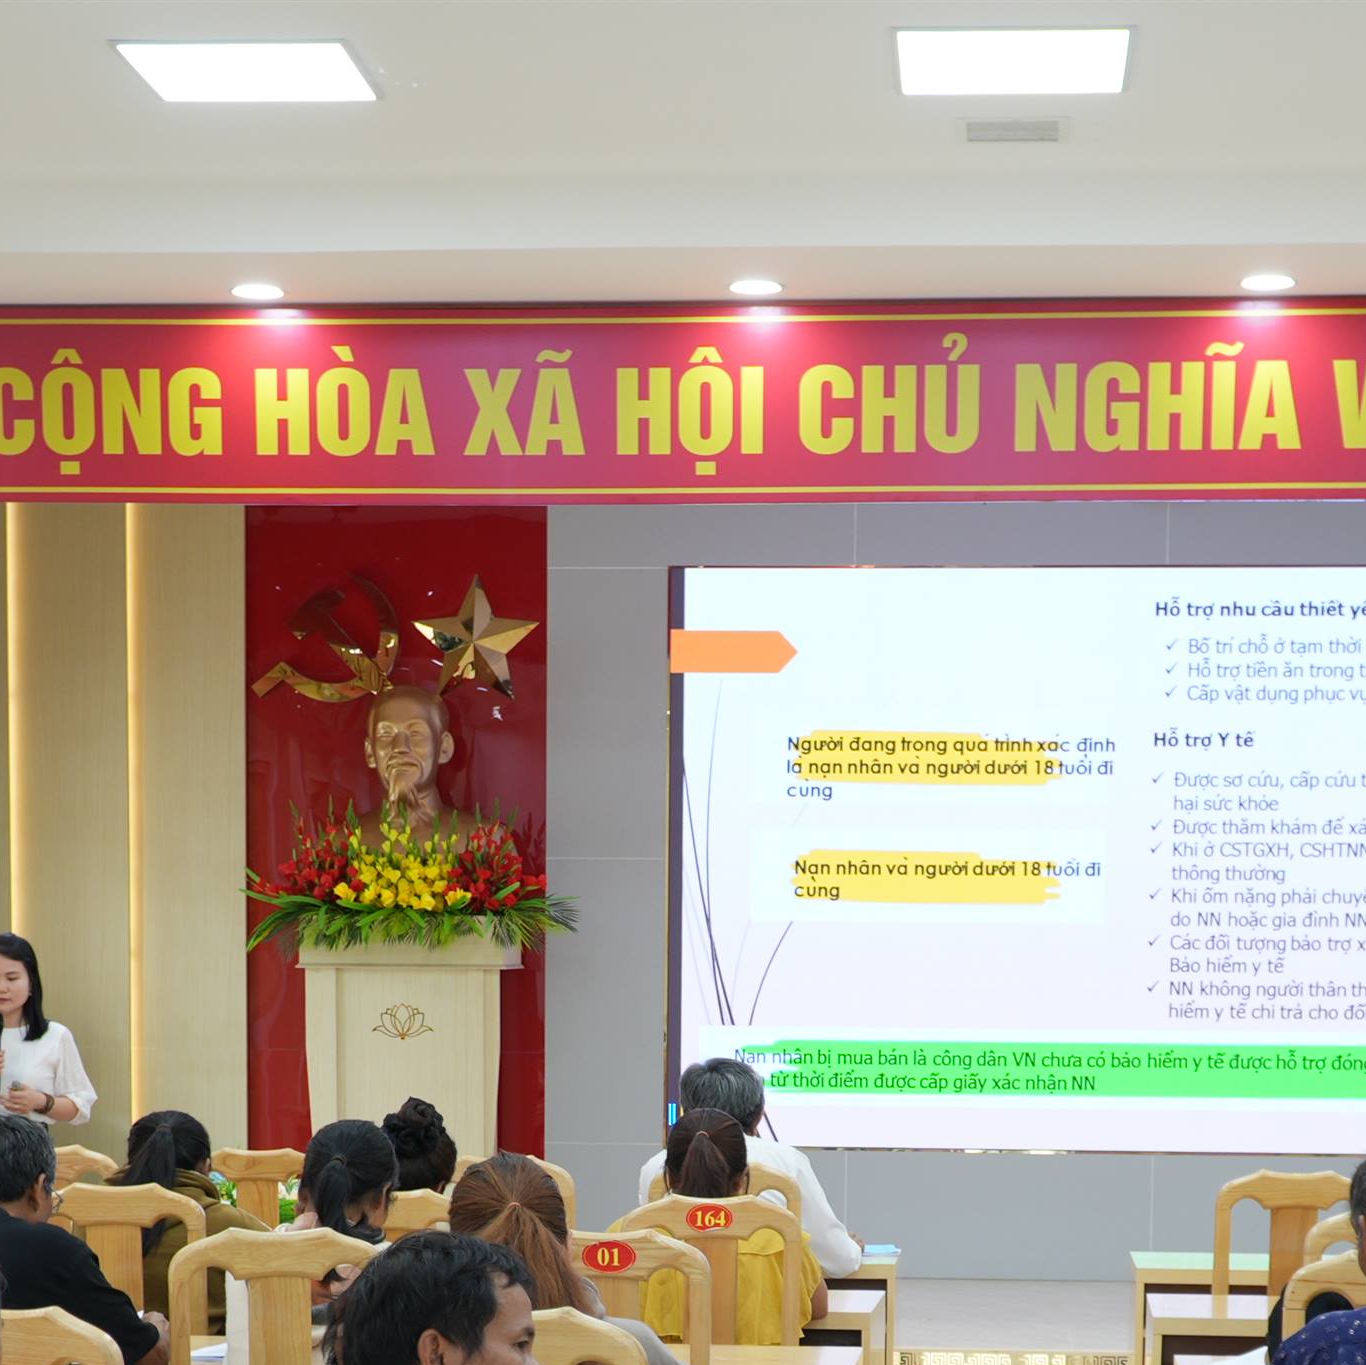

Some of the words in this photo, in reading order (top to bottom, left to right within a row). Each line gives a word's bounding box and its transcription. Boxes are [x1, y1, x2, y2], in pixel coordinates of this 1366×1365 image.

[254, 344, 435, 457] HÒA
[465, 350, 585, 456] XÃ
[617, 346, 765, 476] HỘI
[799, 331, 981, 455] CHỦ
[1015, 341, 1302, 453] NGHĨA
[1156, 596, 1180, 616] Hỗ
[1187, 602, 1215, 620] trợ
[1220, 601, 1256, 616] nhu
[1261, 600, 1294, 616] cầu
[1300, 600, 1345, 616] thiết
[1188, 637, 1210, 654] Bố
[1215, 636, 1233, 654] trí
[1238, 633, 1269, 654] chỗ
[1273, 637, 1286, 654] ở
[1290, 640, 1323, 658] tạm
[1329, 636, 1362, 654] thời
[1188, 657, 1211, 678] Hỗ
[1216, 663, 1241, 682] trợ
[1246, 661, 1278, 678] tiền
[1282, 661, 1304, 678] ăn
[1309, 663, 1354, 682] trong
[1187, 684, 1219, 704] Cấp
[1224, 684, 1251, 704] vật
[1256, 685, 1299, 705] dụng
[1304, 685, 1345, 704] phục
[788, 736, 843, 756] Người
[849, 737, 896, 755] đang
[901, 737, 947, 757] trong
[953, 733, 988, 755] quá
[994, 734, 1032, 752] trình
[1037, 734, 1069, 752] xác
[1154, 727, 1179, 747] Hỗ
[1185, 733, 1213, 751] trợ
[1218, 732, 1229, 747] Y
[1236, 731, 1254, 747] tế
[787, 755, 802, 774] là
[809, 763, 842, 779] nạn
[848, 758, 893, 774] nhân
[898, 756, 919, 774] và
[926, 760, 980, 778] người
[984, 760, 1027, 775] dưới
[1036, 760, 1054, 775] 18
[1058, 754, 1091, 775] tuổi
[1097, 761, 1113, 775] đi
[787, 778, 832, 801] cùng
[1172, 841, 1198, 857] Khi
[1203, 841, 1215, 857] ở
[1220, 840, 1294, 860] CSTGXH,
[836, 860, 881, 875] nhân
[886, 857, 907, 875] và
[915, 861, 968, 879] người
[973, 861, 1015, 876] dưới
[1022, 861, 1041, 876] 18
[1046, 859, 1079, 876] tuổi
[1085, 862, 1100, 876] đi
[1172, 864, 1220, 885] thông
[1225, 864, 1286, 885] thường
[794, 876, 840, 901] cùng
[1170, 955, 1201, 975] Bảo
[1252, 960, 1261, 977] y
[1267, 955, 1284, 974] tế
[772, 1048, 813, 1064] nhân
[818, 1049, 831, 1068] bị
[838, 1054, 873, 1065] mua
[878, 1049, 908, 1065] bán
[914, 1049, 926, 1065] là
[933, 1050, 972, 1070] công
[977, 1050, 1007, 1066] dân
[1013, 1052, 1035, 1067] VN
[1042, 1052, 1082, 1067] chưa
[1087, 1050, 1105, 1068] có
[1111, 1052, 1141, 1068] bảo
[1148, 1050, 1187, 1068] hiểm
[1193, 1057, 1202, 1072] y
[1208, 1053, 1224, 1069] tế
[1229, 1053, 1271, 1073] được
[1277, 1050, 1297, 1070] hỗ
[1302, 1056, 1327, 1074] trợ
[771, 1070, 789, 1087] từ
[793, 1070, 824, 1087] thời
[828, 1069, 868, 1088] điểm
[874, 1073, 916, 1092] được
[920, 1073, 948, 1092] cấp
[953, 1073, 987, 1093] giấy
[992, 1073, 1020, 1089] xác
[1026, 1074, 1067, 1094] nhận
[1072, 1076, 1095, 1090] NN
[696, 1210, 726, 1226] 164
[597, 1247, 620, 1266] 01
